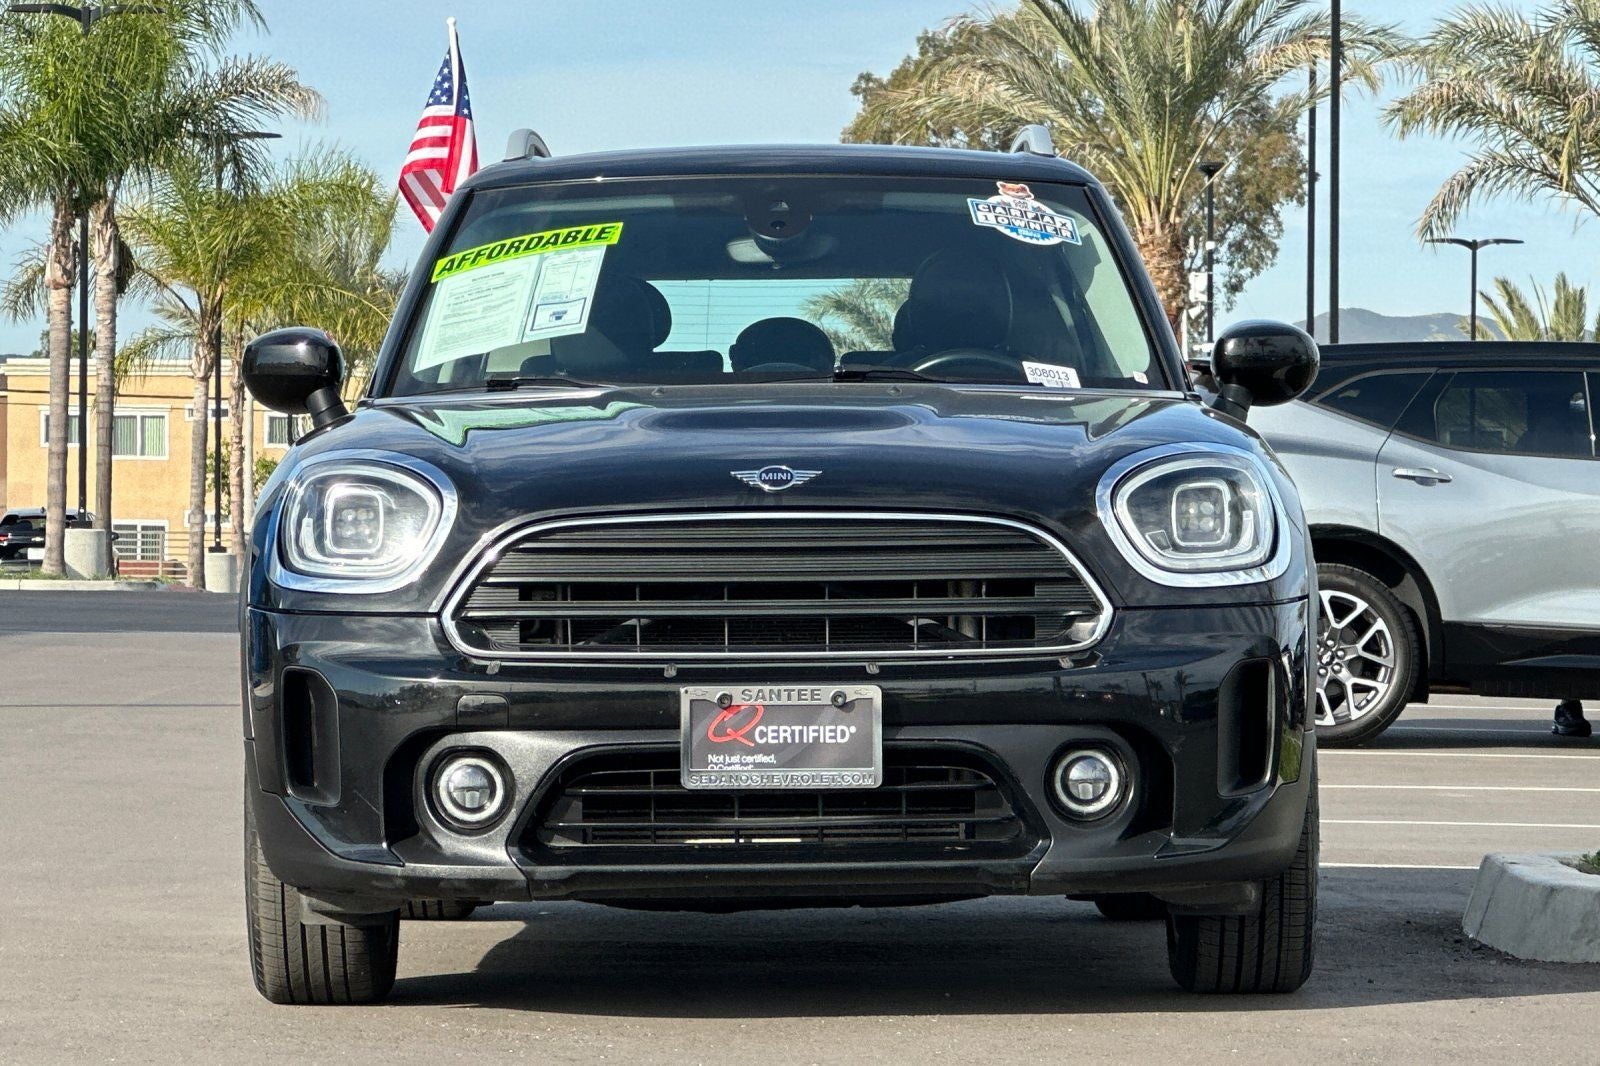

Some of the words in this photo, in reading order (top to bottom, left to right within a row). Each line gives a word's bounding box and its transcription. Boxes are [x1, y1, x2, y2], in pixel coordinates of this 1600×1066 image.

[977, 203, 1069, 230] CARFAX
[997, 215, 1073, 238] OWNER
[435, 225, 618, 278] AFFORDABLE
[1027, 366, 1070, 381] 308013
[761, 472, 791, 481] MINI
[741, 688, 822, 702] SANTEE
[707, 754, 724, 763] Not
[725, 754, 740, 765] just
[741, 753, 777, 764] certified,
